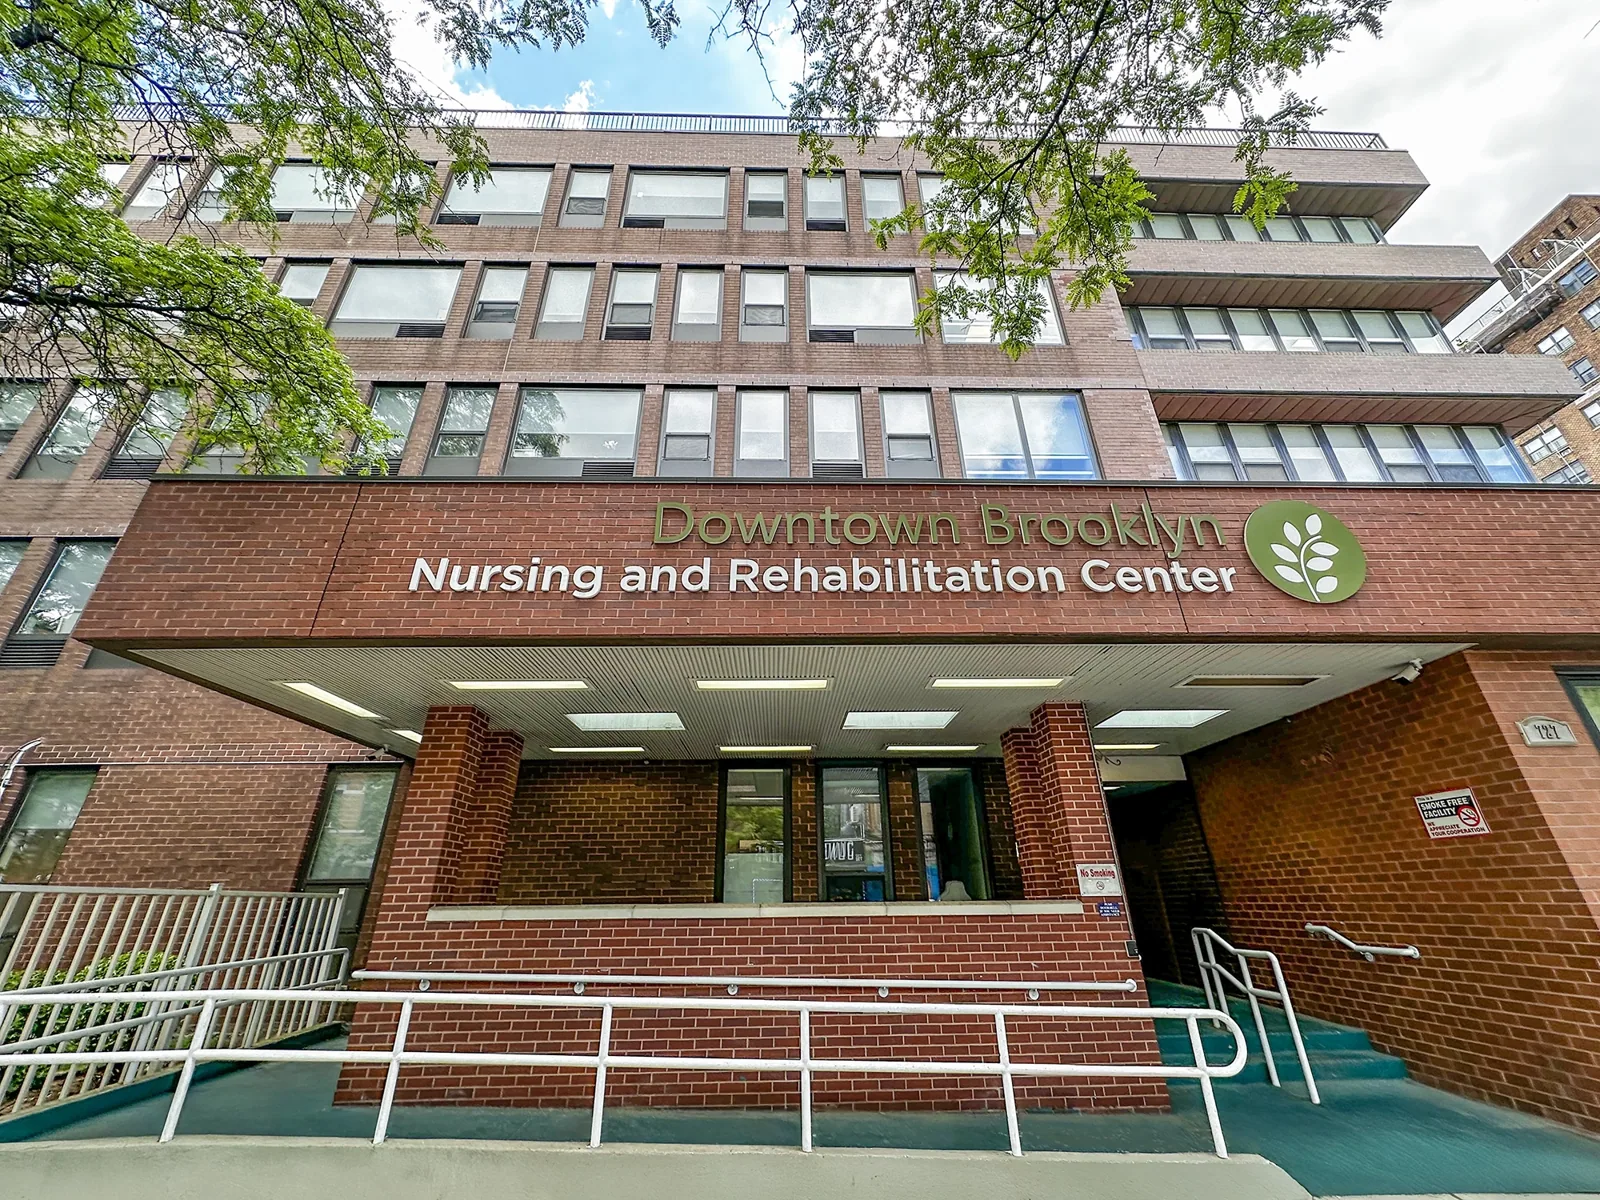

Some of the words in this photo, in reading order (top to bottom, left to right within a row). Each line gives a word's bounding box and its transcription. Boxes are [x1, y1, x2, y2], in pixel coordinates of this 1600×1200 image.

[653, 502, 961, 546] Downtown
[981, 502, 1227, 559] Brooklyn
[407, 557, 604, 599] Nursing
[620, 557, 711, 593] and
[729, 557, 1066, 593] Rehabilitation
[1080, 558, 1237, 594] Center
[1534, 724, 1561, 740] 121
[1420, 800, 1447, 811] SMOKE
[1446, 797, 1469, 807] FREE
[1423, 807, 1456, 818] FACILITY
[1429, 824, 1461, 832] APPRECIATE
[1446, 827, 1486, 836] COOPERATION
[1080, 869, 1089, 878] No
[1090, 869, 1116, 879] Smoking
